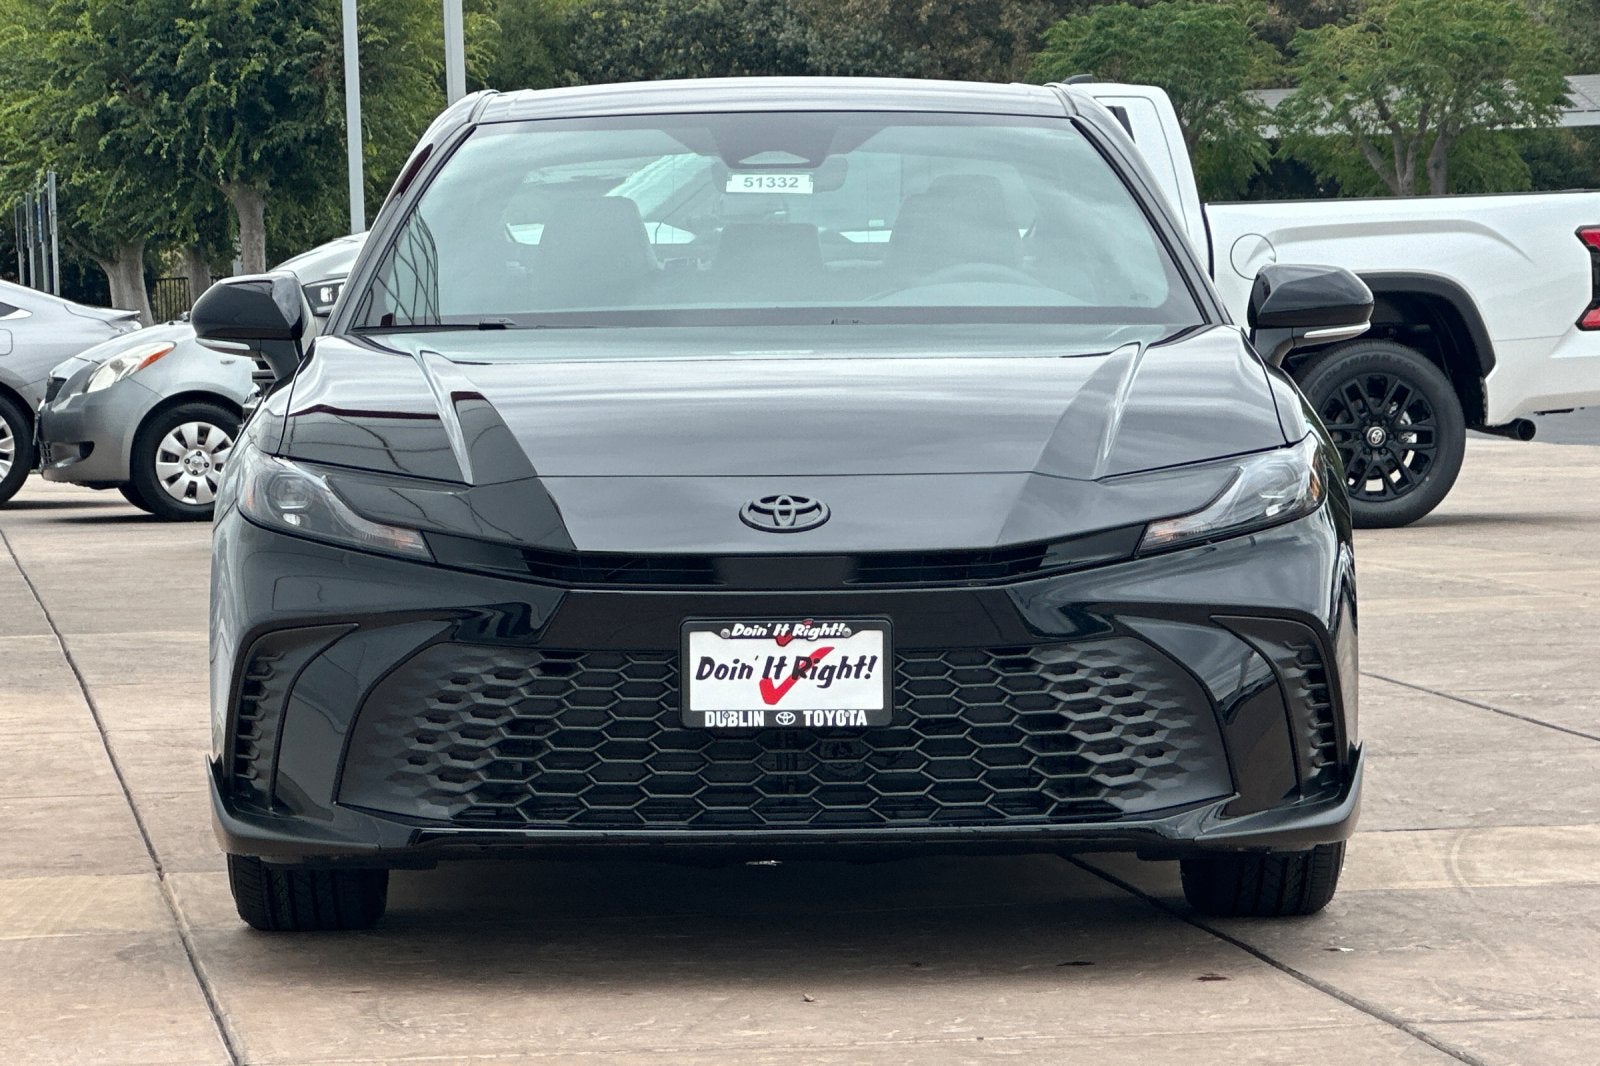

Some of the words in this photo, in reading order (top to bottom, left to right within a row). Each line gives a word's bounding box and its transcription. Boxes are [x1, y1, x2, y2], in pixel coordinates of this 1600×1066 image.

[743, 177, 799, 188] 51332
[731, 622, 772, 638] Doin'
[775, 623, 790, 638] It
[793, 622, 845, 641] Right!
[696, 655, 759, 681] Doin'
[762, 655, 788, 680] It
[791, 654, 878, 689] Right!
[704, 711, 765, 728] DUBLIN
[803, 709, 868, 727] TOYOTA
